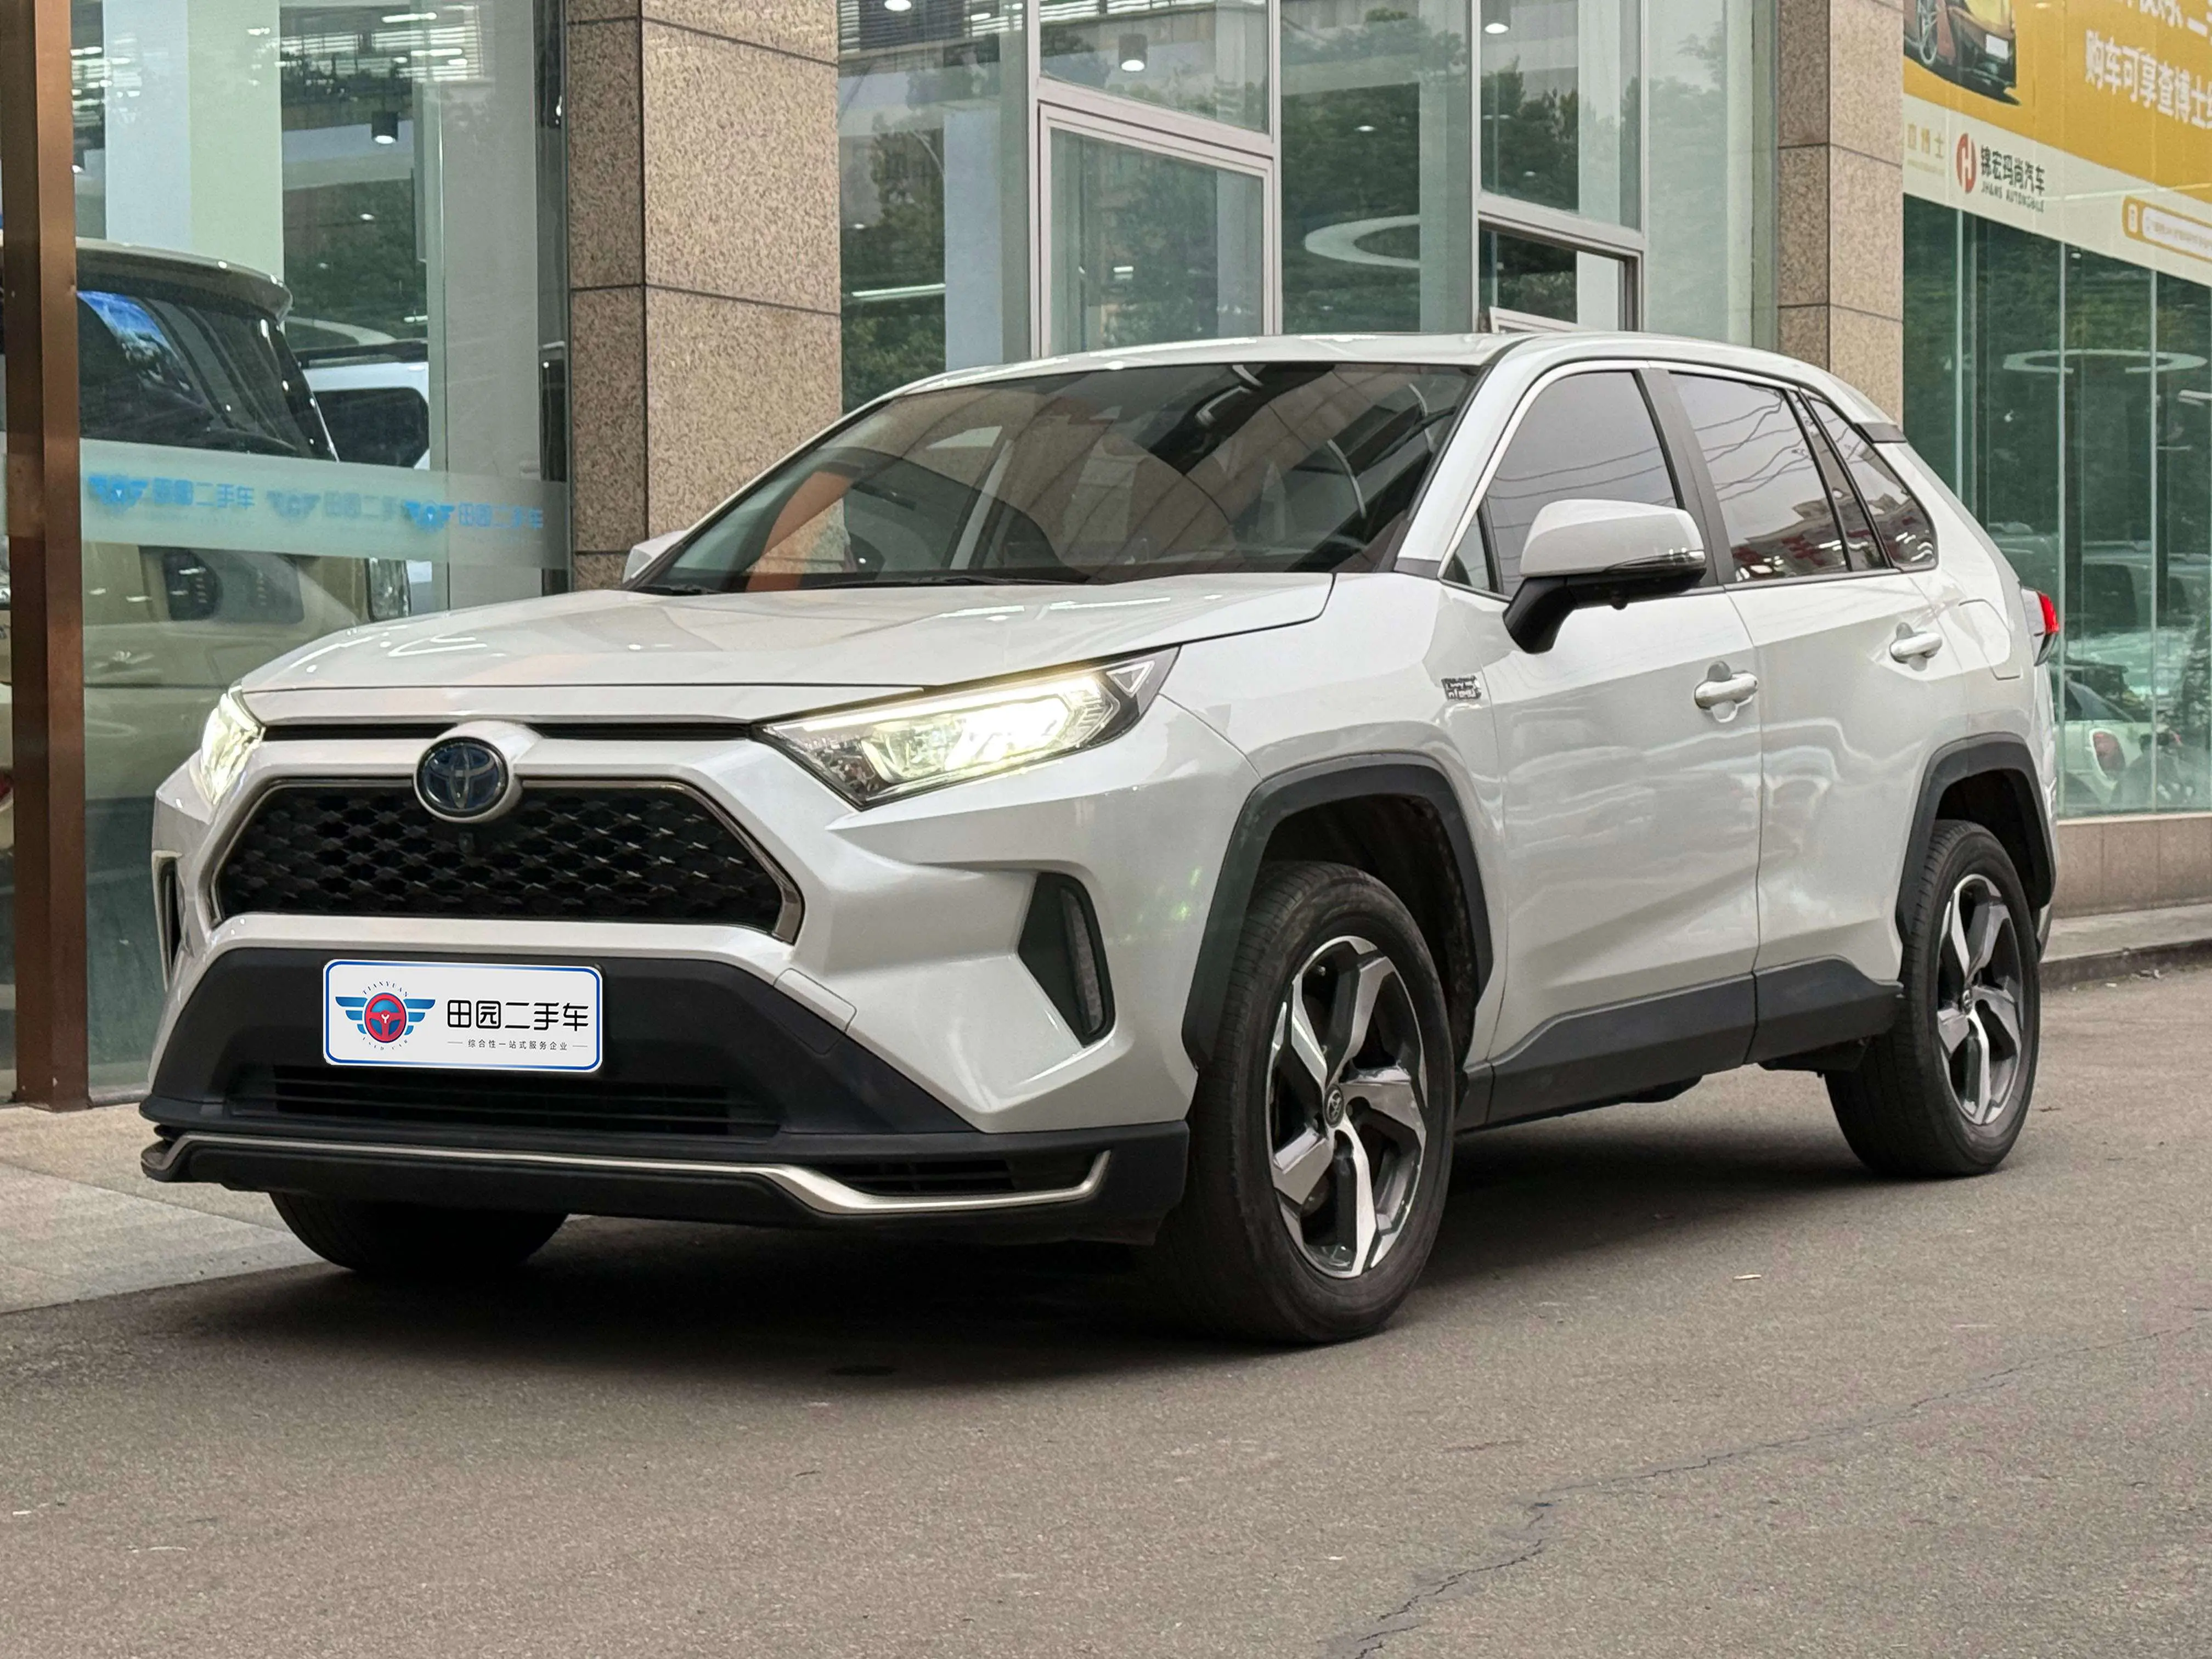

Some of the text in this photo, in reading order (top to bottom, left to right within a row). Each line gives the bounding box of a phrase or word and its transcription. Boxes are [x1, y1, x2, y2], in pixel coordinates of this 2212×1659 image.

[2086, 29, 2212, 128] 购车可享查博士
[447, 1000, 589, 1031] 田园二手车
[468, 1039, 567, 1051] 综合性一站式服务企业
